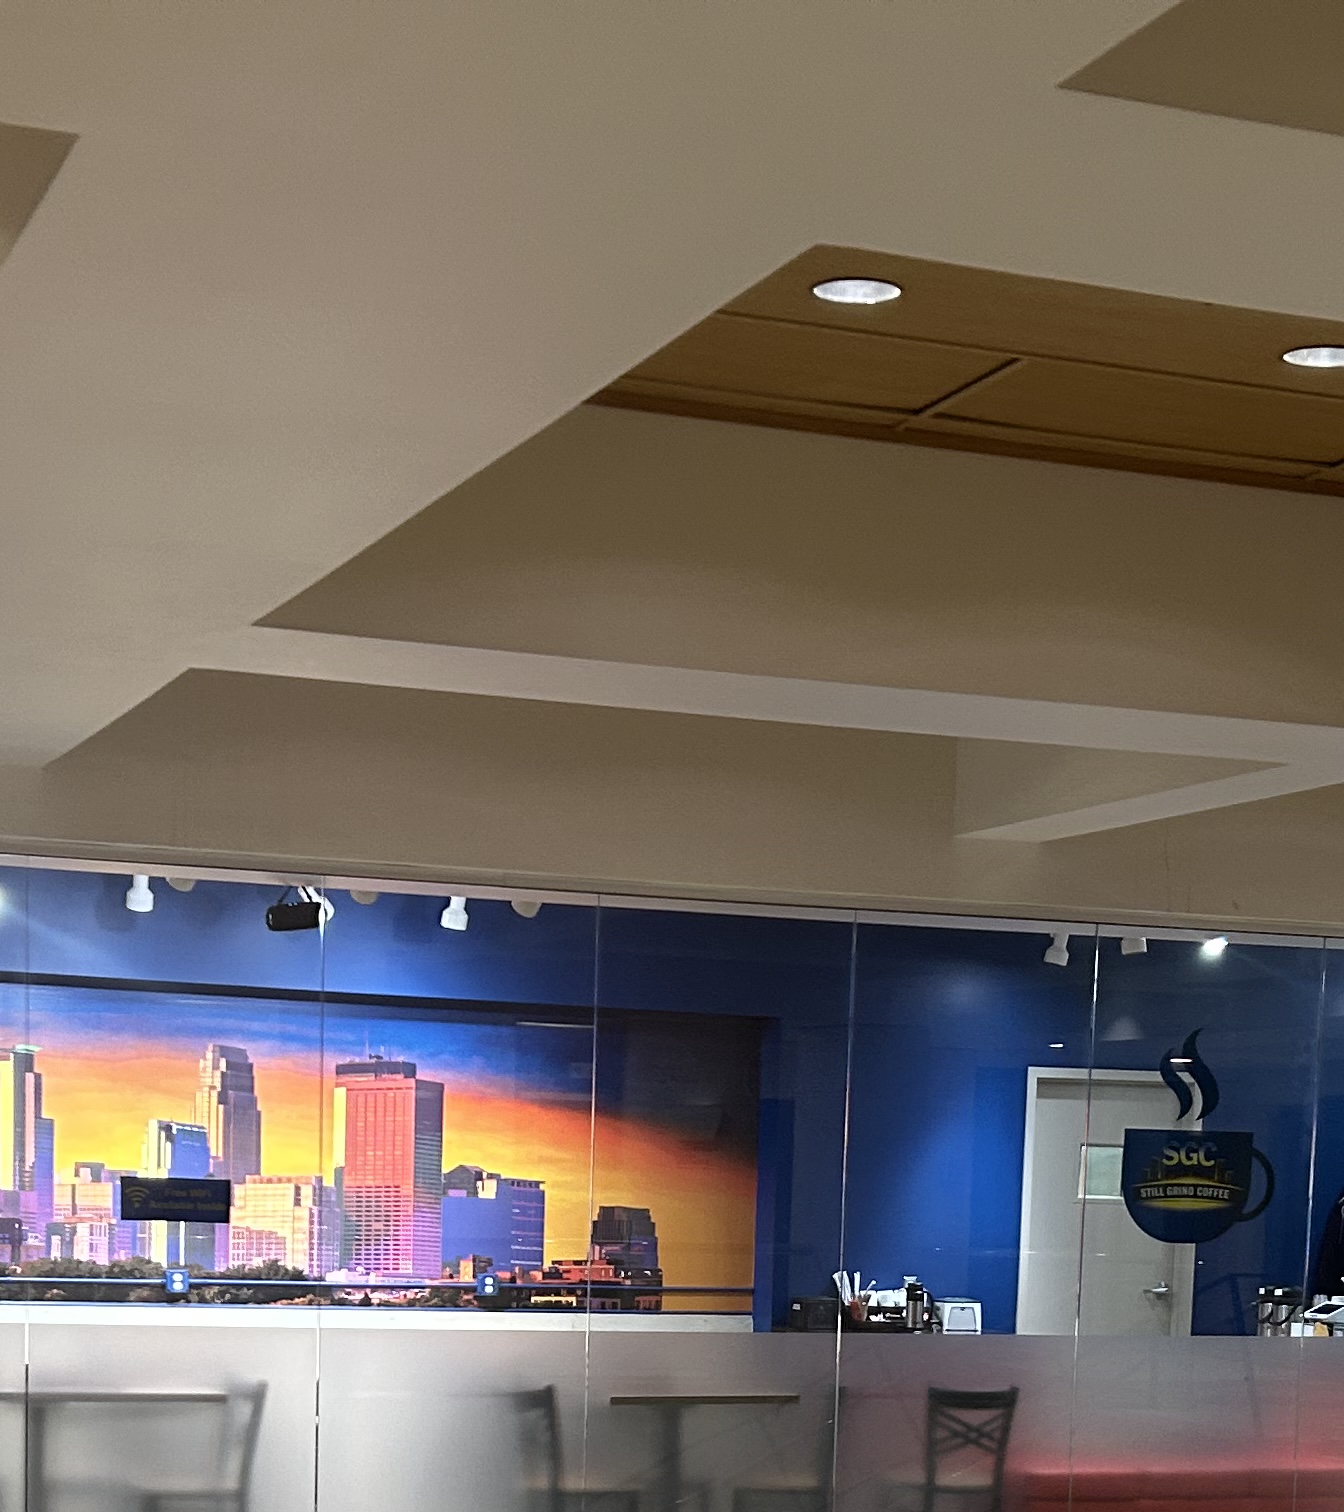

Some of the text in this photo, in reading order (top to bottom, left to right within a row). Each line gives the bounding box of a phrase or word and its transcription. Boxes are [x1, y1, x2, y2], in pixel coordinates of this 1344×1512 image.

[1162, 1140, 1217, 1167] SGC
[1140, 1186, 1230, 1200] STILL GRIND COFFEE
